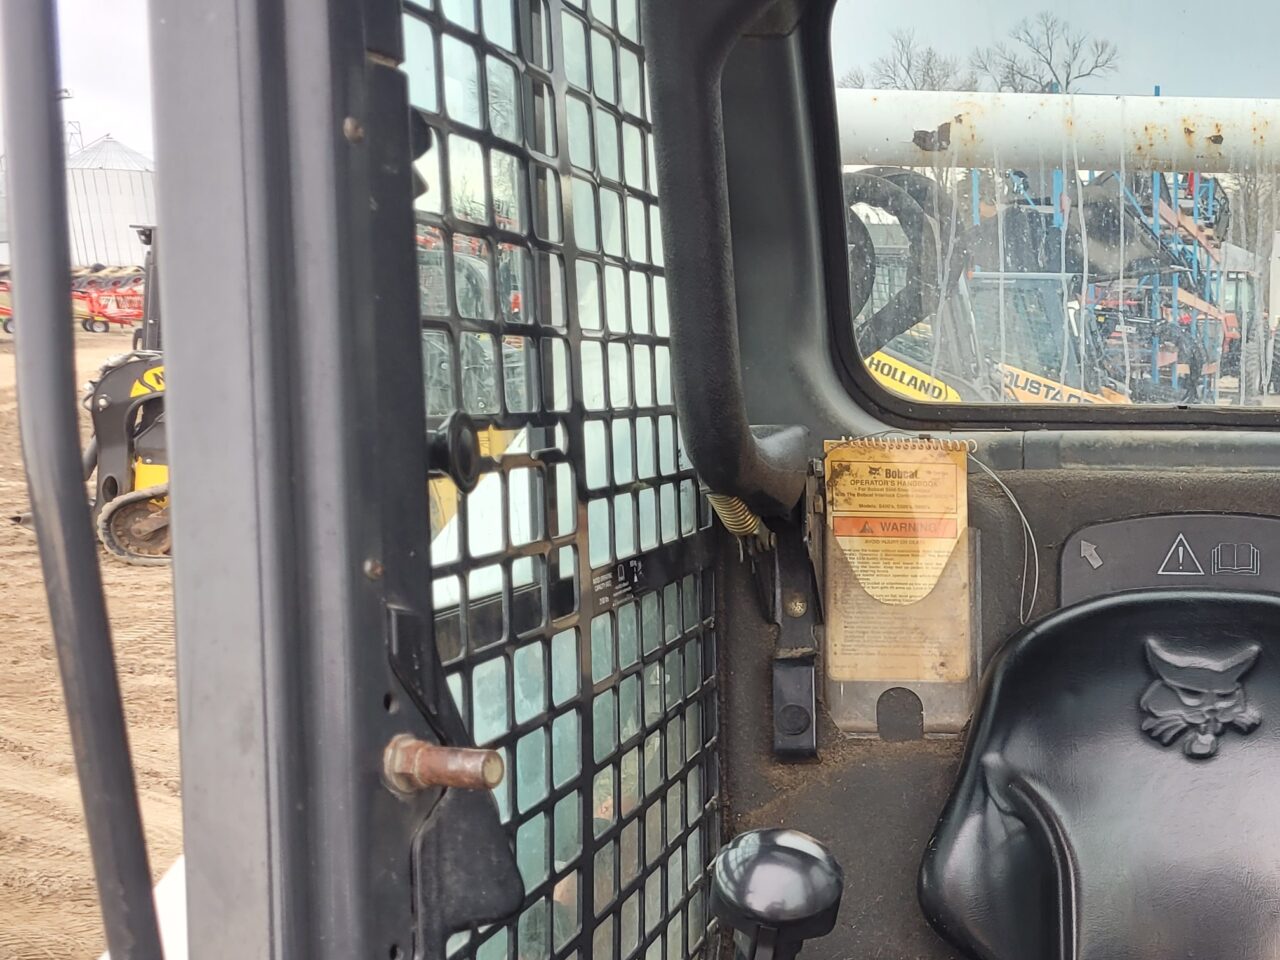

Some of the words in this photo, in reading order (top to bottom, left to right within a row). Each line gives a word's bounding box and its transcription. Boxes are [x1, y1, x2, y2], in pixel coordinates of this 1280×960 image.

[868, 356, 943, 400] HOLLAND
[885, 468, 918, 479] Bobcat
[850, 479, 896, 487] OPERATOR'S
[880, 521, 939, 533] WARNING
